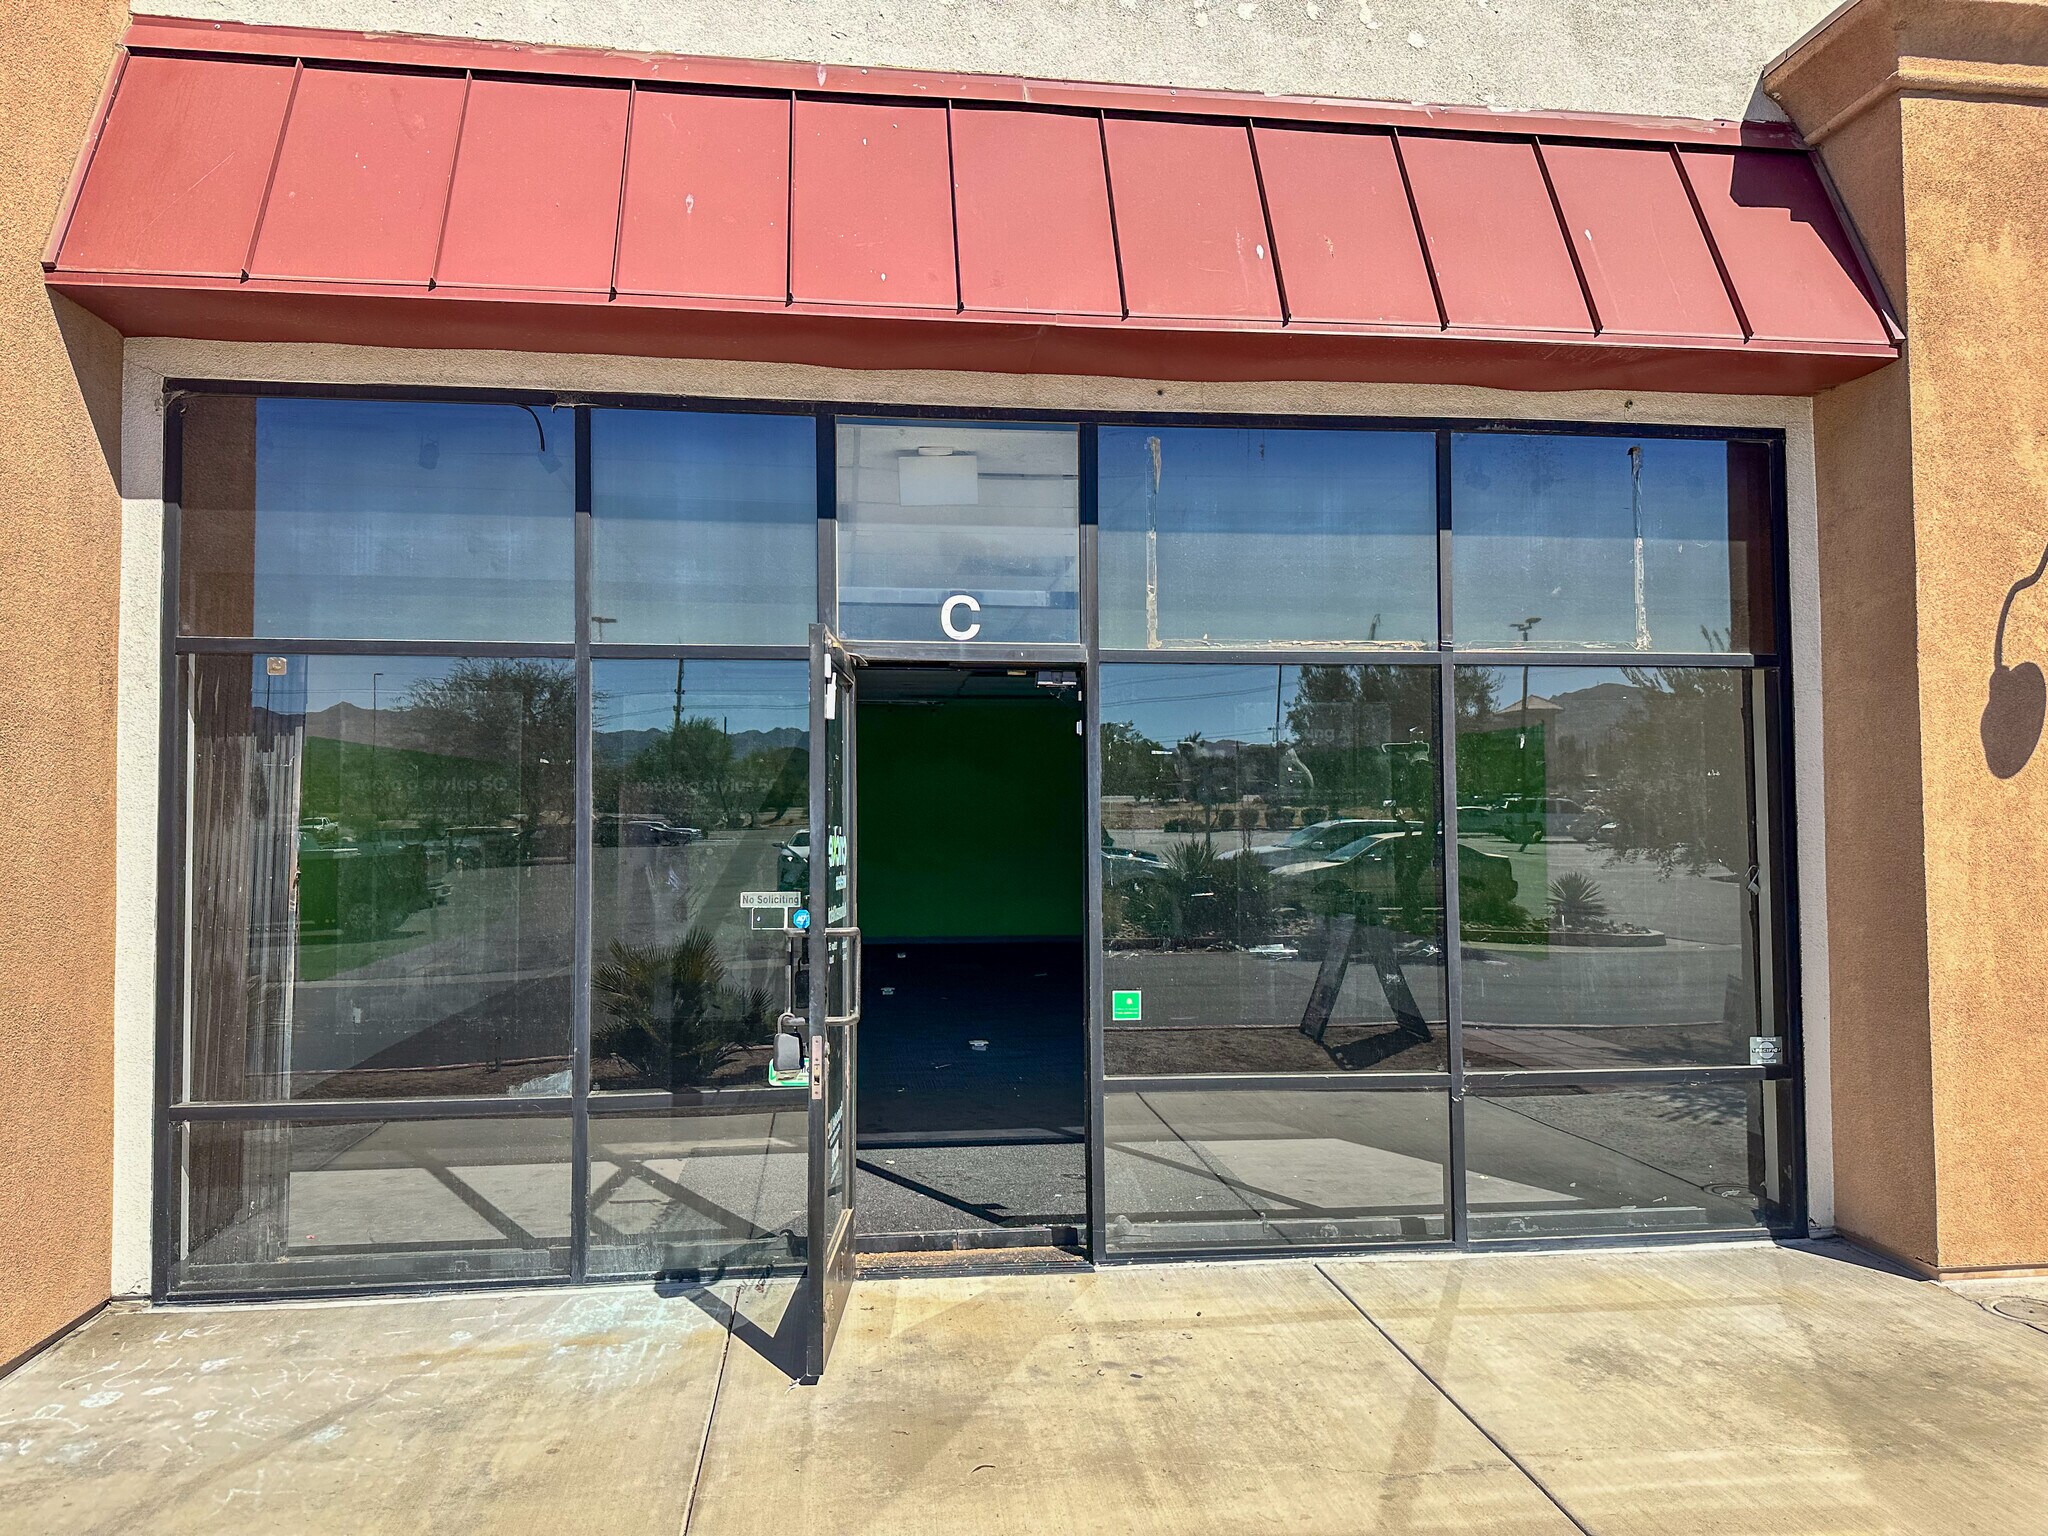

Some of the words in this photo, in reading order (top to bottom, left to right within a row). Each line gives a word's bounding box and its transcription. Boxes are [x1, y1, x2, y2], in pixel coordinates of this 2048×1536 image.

[941, 594, 981, 641] C
[742, 895, 755, 904] No
[757, 894, 799, 906] Soliciting
